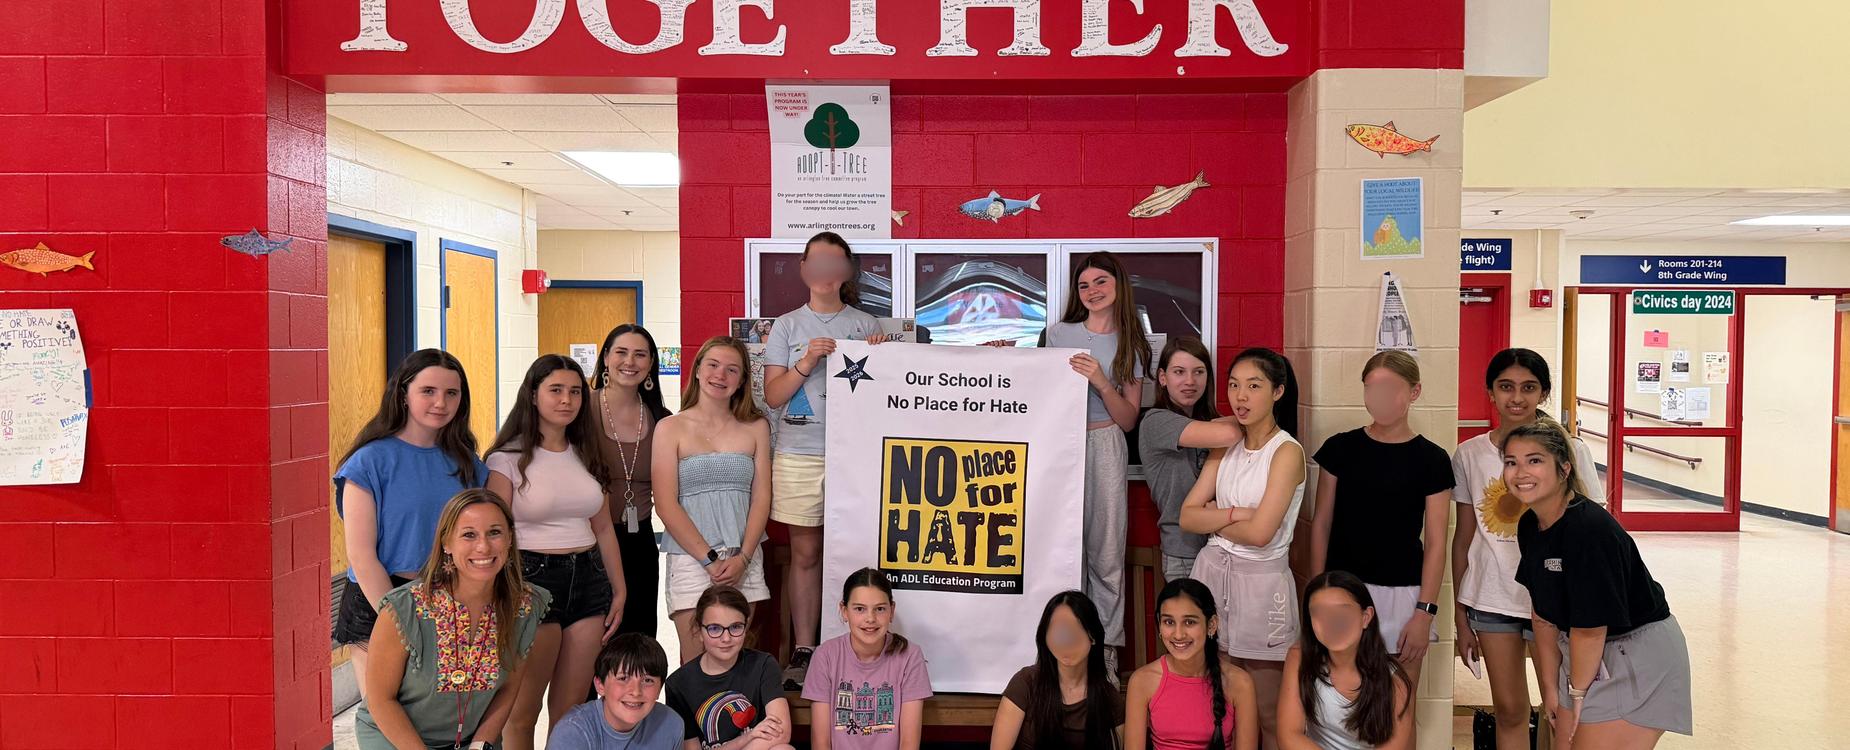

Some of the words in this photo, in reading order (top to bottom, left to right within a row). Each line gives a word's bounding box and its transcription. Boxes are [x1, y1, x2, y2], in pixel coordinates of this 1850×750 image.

[787, 222, 876, 231] www.arlingtontrees.org
[1476, 243, 1502, 254] Wing
[1465, 255, 1495, 267] flight)
[1658, 260, 1689, 268] Rooms
[1690, 260, 1722, 268] 201-214
[1657, 271, 1673, 279] 8th
[1675, 271, 1702, 280] Grade
[1703, 272, 1728, 282] Wing
[1641, 293, 1678, 309] Civics
[1681, 294, 1702, 312] day
[1704, 295, 1732, 309] 2024
[9, 318, 22, 329] OR
[27, 316, 54, 327] DRAW
[846, 363, 859, 375] 2025
[905, 371, 934, 386] Our
[938, 372, 992, 388] School
[998, 374, 1011, 388] is
[887, 395, 909, 409] No
[914, 396, 958, 411] Place
[962, 397, 986, 412] for
[990, 399, 1028, 414] Hate
[889, 445, 958, 507] NO
[962, 449, 1017, 482] place
[965, 482, 1018, 508] for
[886, 508, 1017, 568] HATE
[886, 573, 899, 583] An
[901, 574, 920, 584] ADL
[923, 574, 971, 586] Education
[973, 577, 1016, 590] Program
[1268, 592, 1286, 639] Nike
